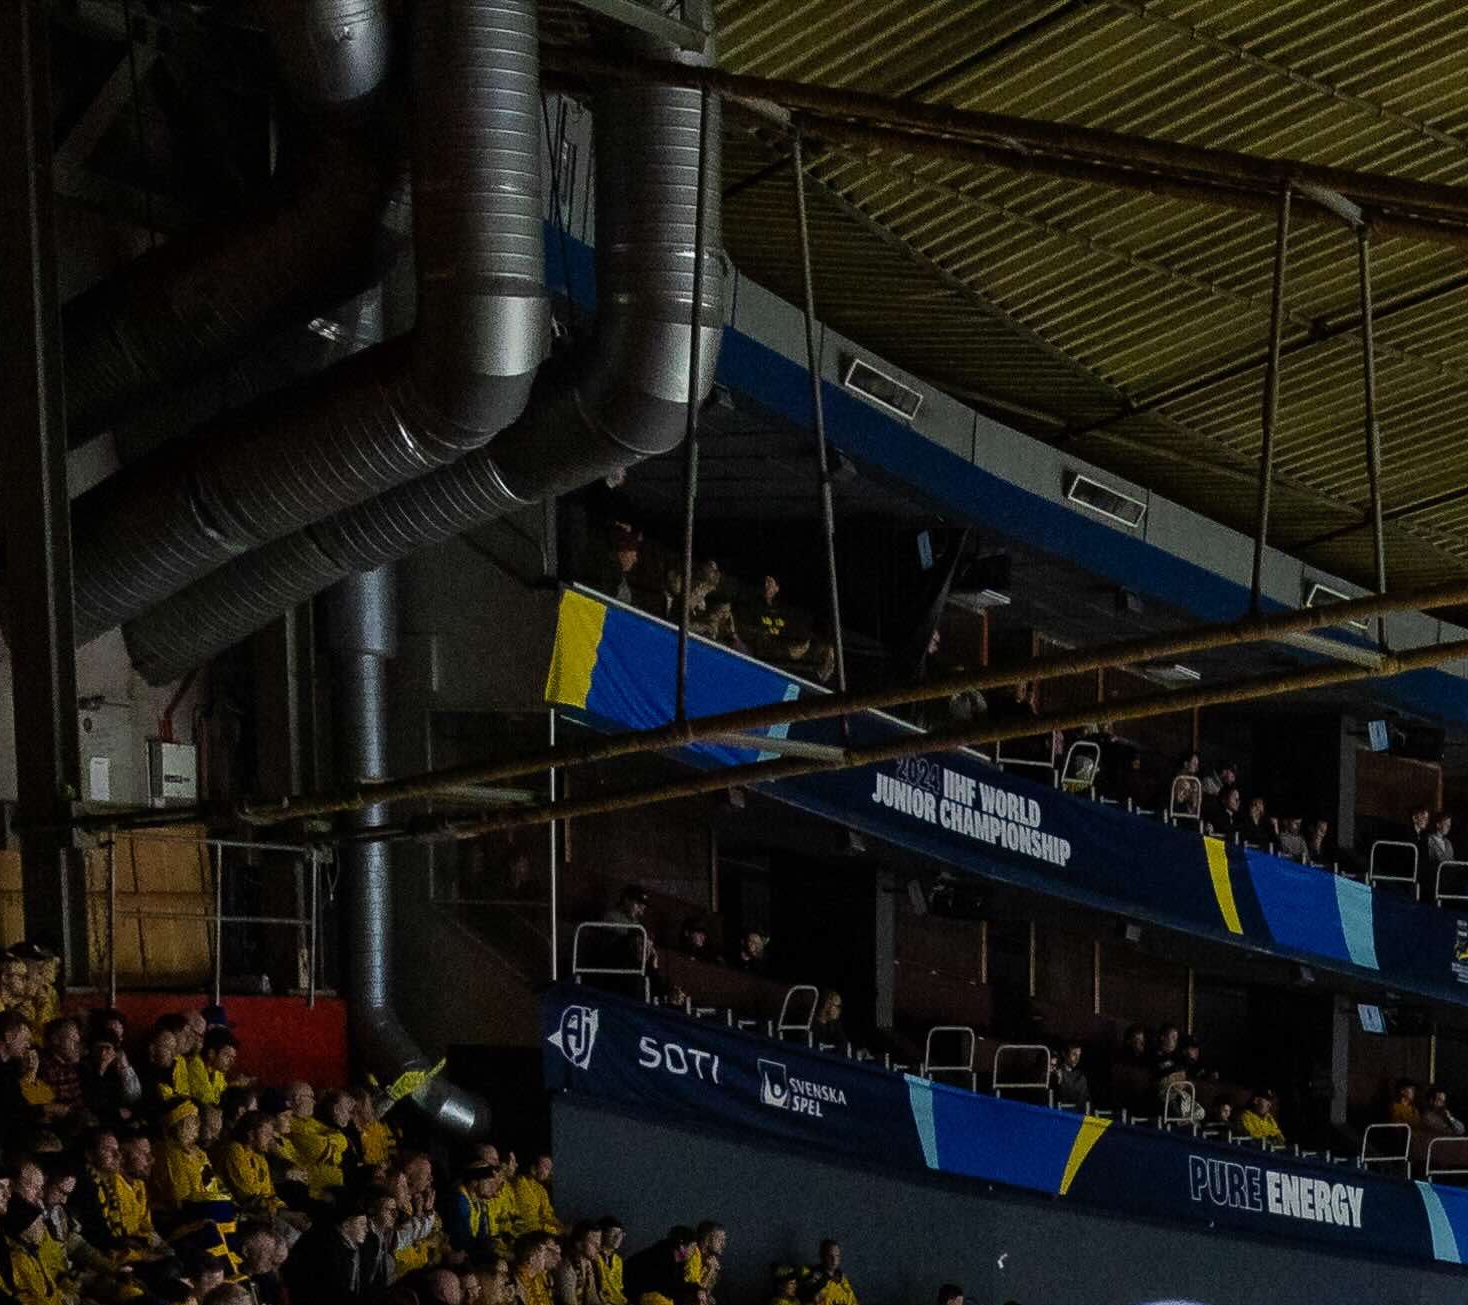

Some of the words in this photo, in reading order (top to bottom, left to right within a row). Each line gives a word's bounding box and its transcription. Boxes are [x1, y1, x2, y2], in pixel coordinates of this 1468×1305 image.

[871, 771, 937, 825] JUNIOR
[939, 799, 1072, 867] CHAMPIONSHIP
[896, 755, 941, 796] 2024
[943, 767, 977, 807] IIHF
[978, 782, 1042, 828] WORLD
[638, 1036, 720, 1085] SOTI
[788, 1077, 848, 1106] SVENSKA
[790, 1094, 824, 1119] SPEL
[1188, 1154, 1263, 1212] PURE
[1265, 1170, 1365, 1228] ENERGY
